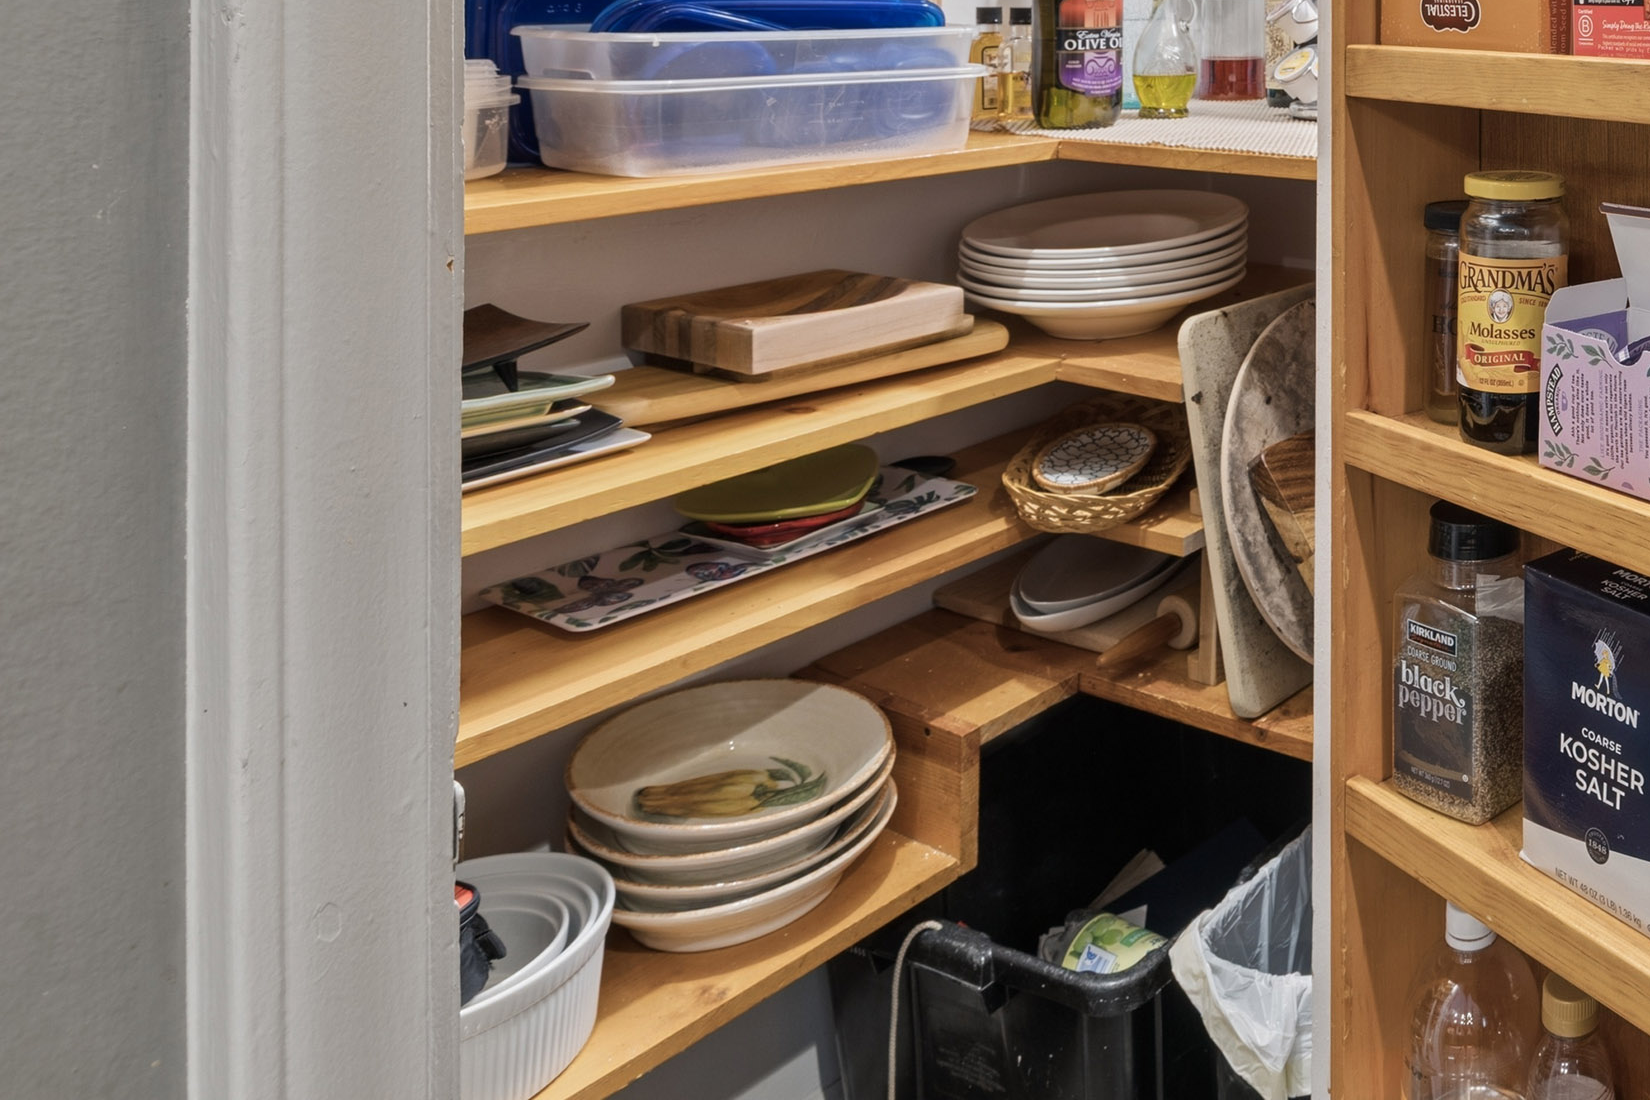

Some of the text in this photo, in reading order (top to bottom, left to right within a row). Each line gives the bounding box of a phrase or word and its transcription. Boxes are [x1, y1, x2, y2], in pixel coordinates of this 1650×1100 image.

[1425, 1, 1475, 22] CELESTIAL
[1064, 38, 1106, 51] OLIVE
[1076, 28, 1121, 40] Extra Virgin
[1460, 260, 1556, 295] GRANDMA'S
[1469, 321, 1536, 340] Molasses
[1474, 352, 1525, 364] ORIGINAL
[1546, 366, 1561, 433] HAMPSTEAD
[1600, 579, 1648, 600] KOSHER
[1600, 586, 1631, 600] SALT
[1410, 623, 1455, 647] KIRKLAND
[1407, 645, 1457, 672] COARSE GROUND
[1400, 659, 1466, 709] black
[1397, 683, 1467, 725] pepper
[1571, 681, 1638, 729] MORTON
[1581, 727, 1622, 755] COARSE
[1560, 732, 1645, 795] KOSHER
[1575, 769, 1626, 811] SALT
[1587, 838, 1607, 855] 1848
[1555, 867, 1568, 881] NET
[1579, 883, 1589, 895] 48
[1588, 888, 1598, 900] OZ
